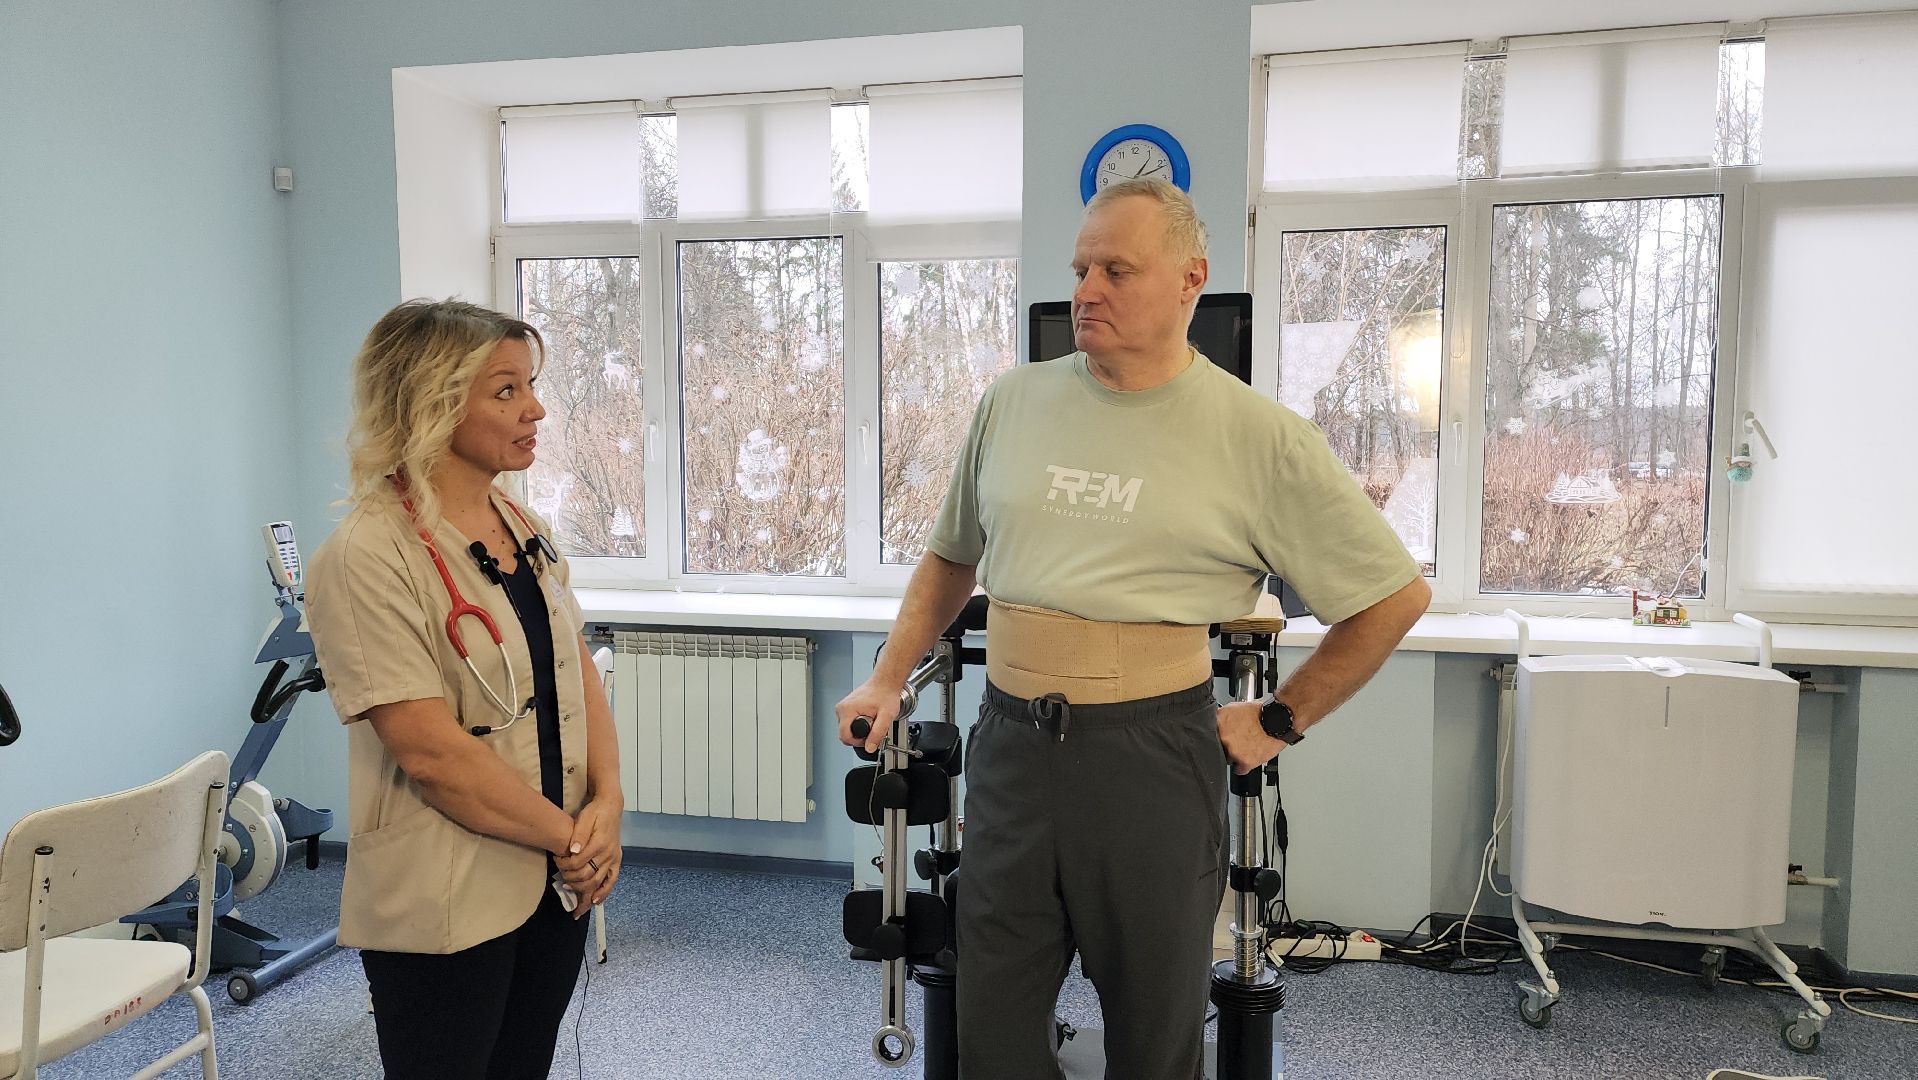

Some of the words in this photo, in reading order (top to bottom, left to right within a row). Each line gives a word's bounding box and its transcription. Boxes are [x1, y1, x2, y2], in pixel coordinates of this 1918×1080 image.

[1118, 151, 1125, 159] 11
[1130, 146, 1140, 155] 12
[1107, 162, 1116, 171] 10
[1157, 160, 1164, 168] 2
[1102, 177, 1109, 186] 9
